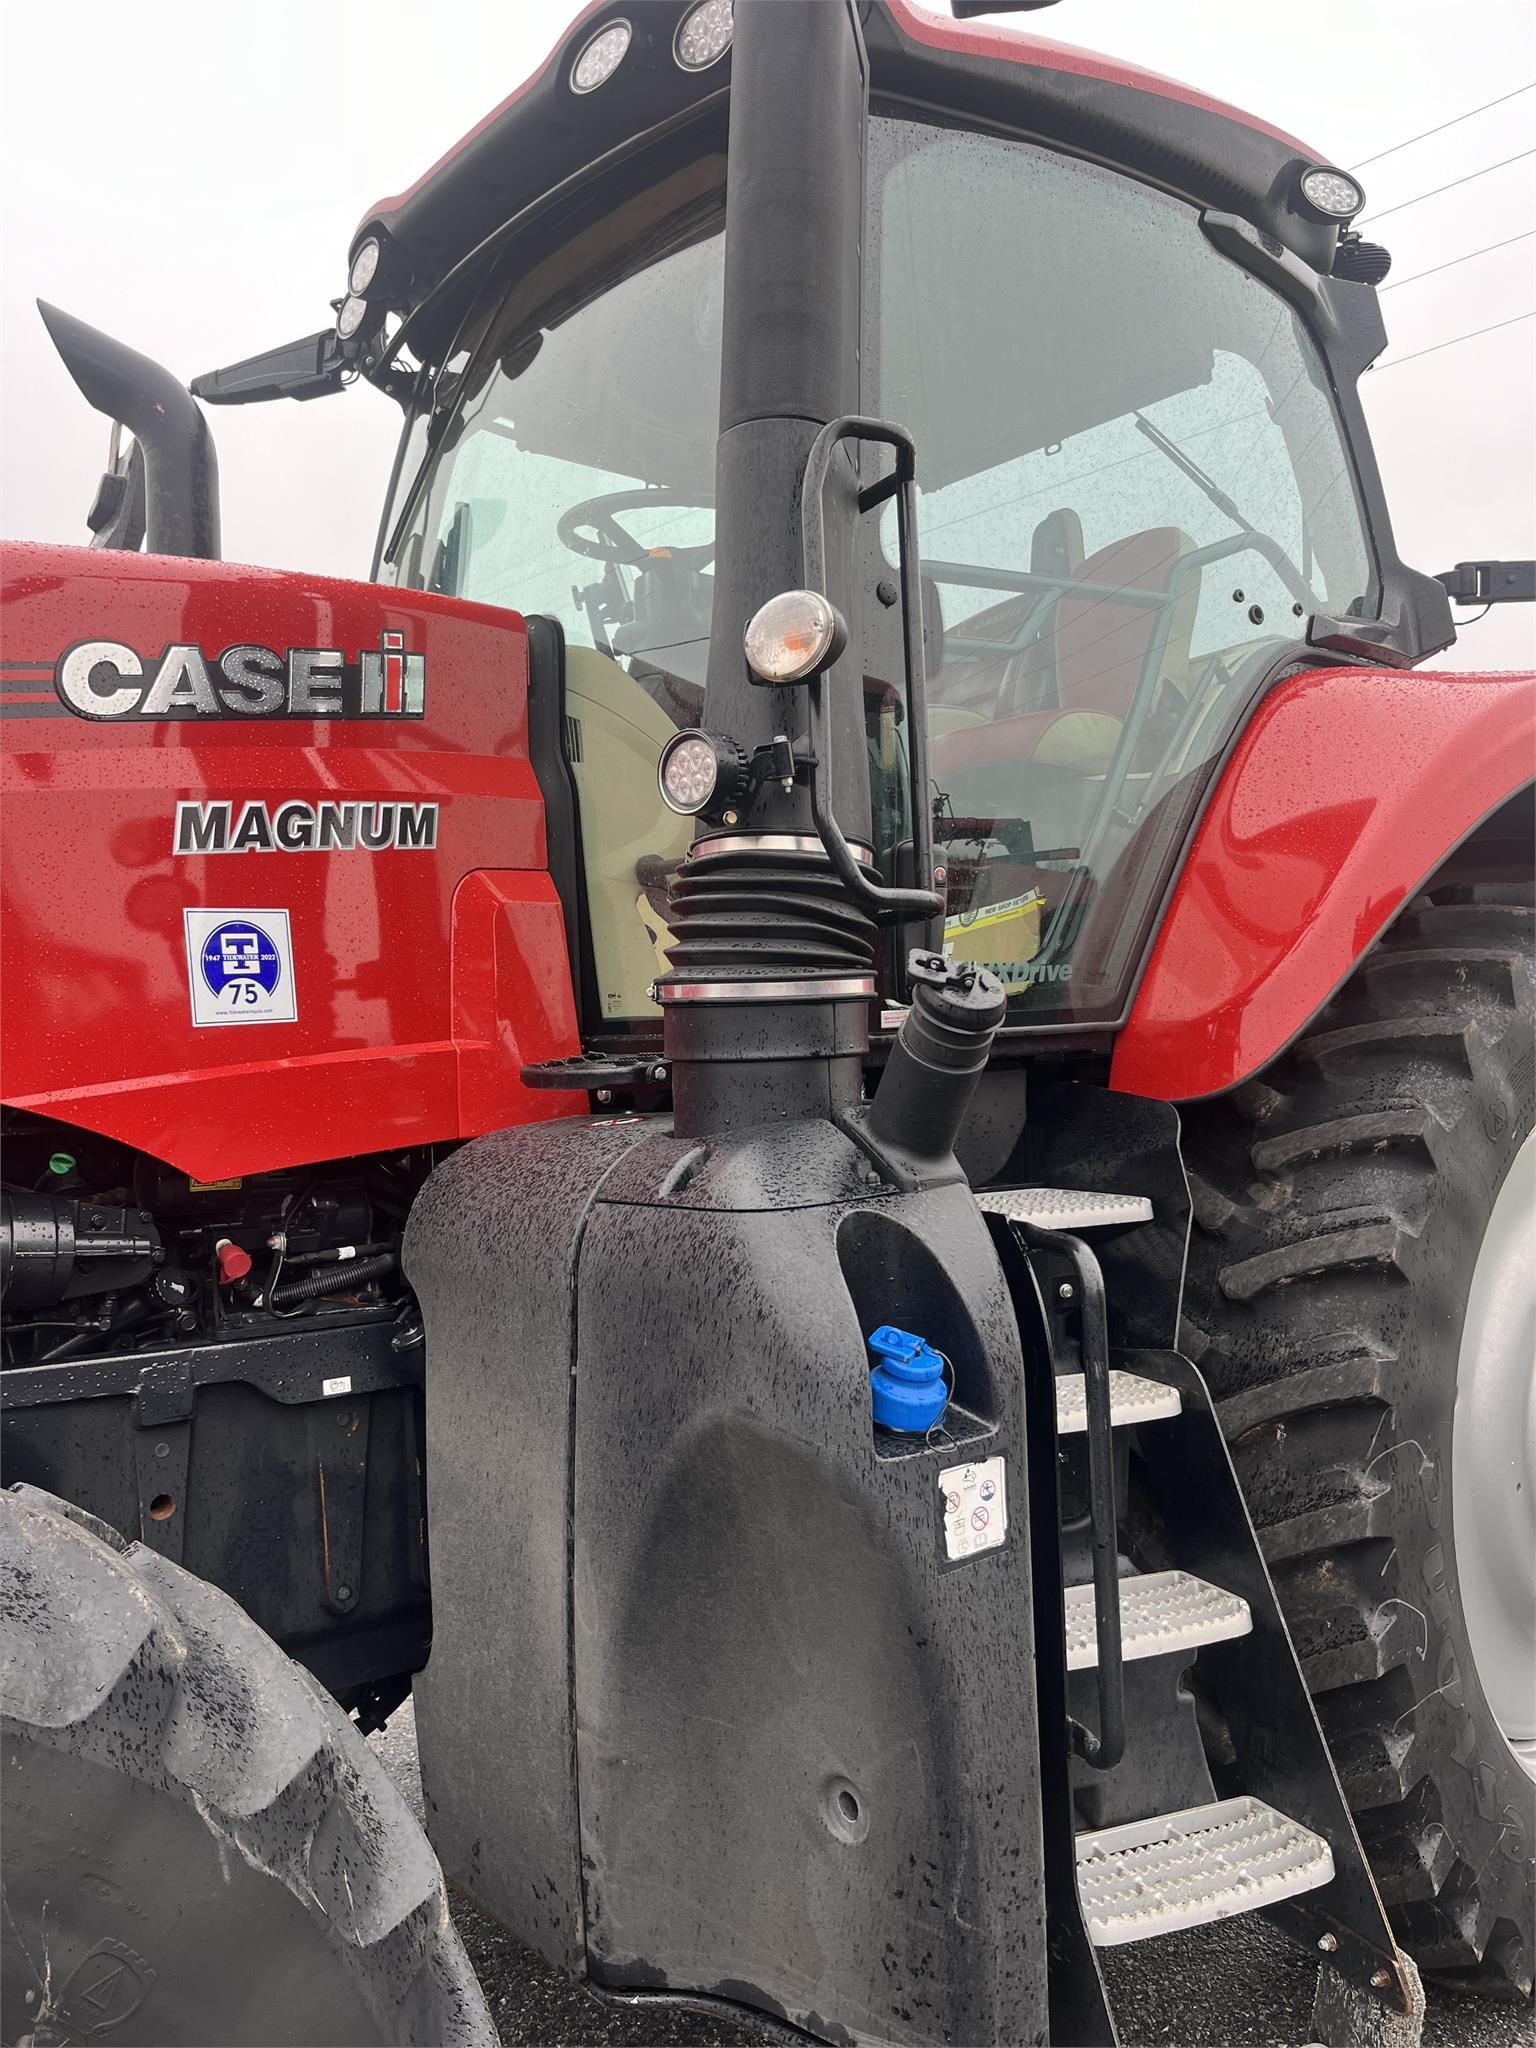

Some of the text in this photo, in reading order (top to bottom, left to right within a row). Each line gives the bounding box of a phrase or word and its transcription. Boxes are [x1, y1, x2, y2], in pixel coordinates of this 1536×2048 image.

[62, 641, 344, 716] CASE
[173, 799, 438, 856] MAGNUM
[998, 902, 1012, 910] SHOP
[223, 954, 259, 962] TIDEWATER
[229, 984, 258, 1005] 75
